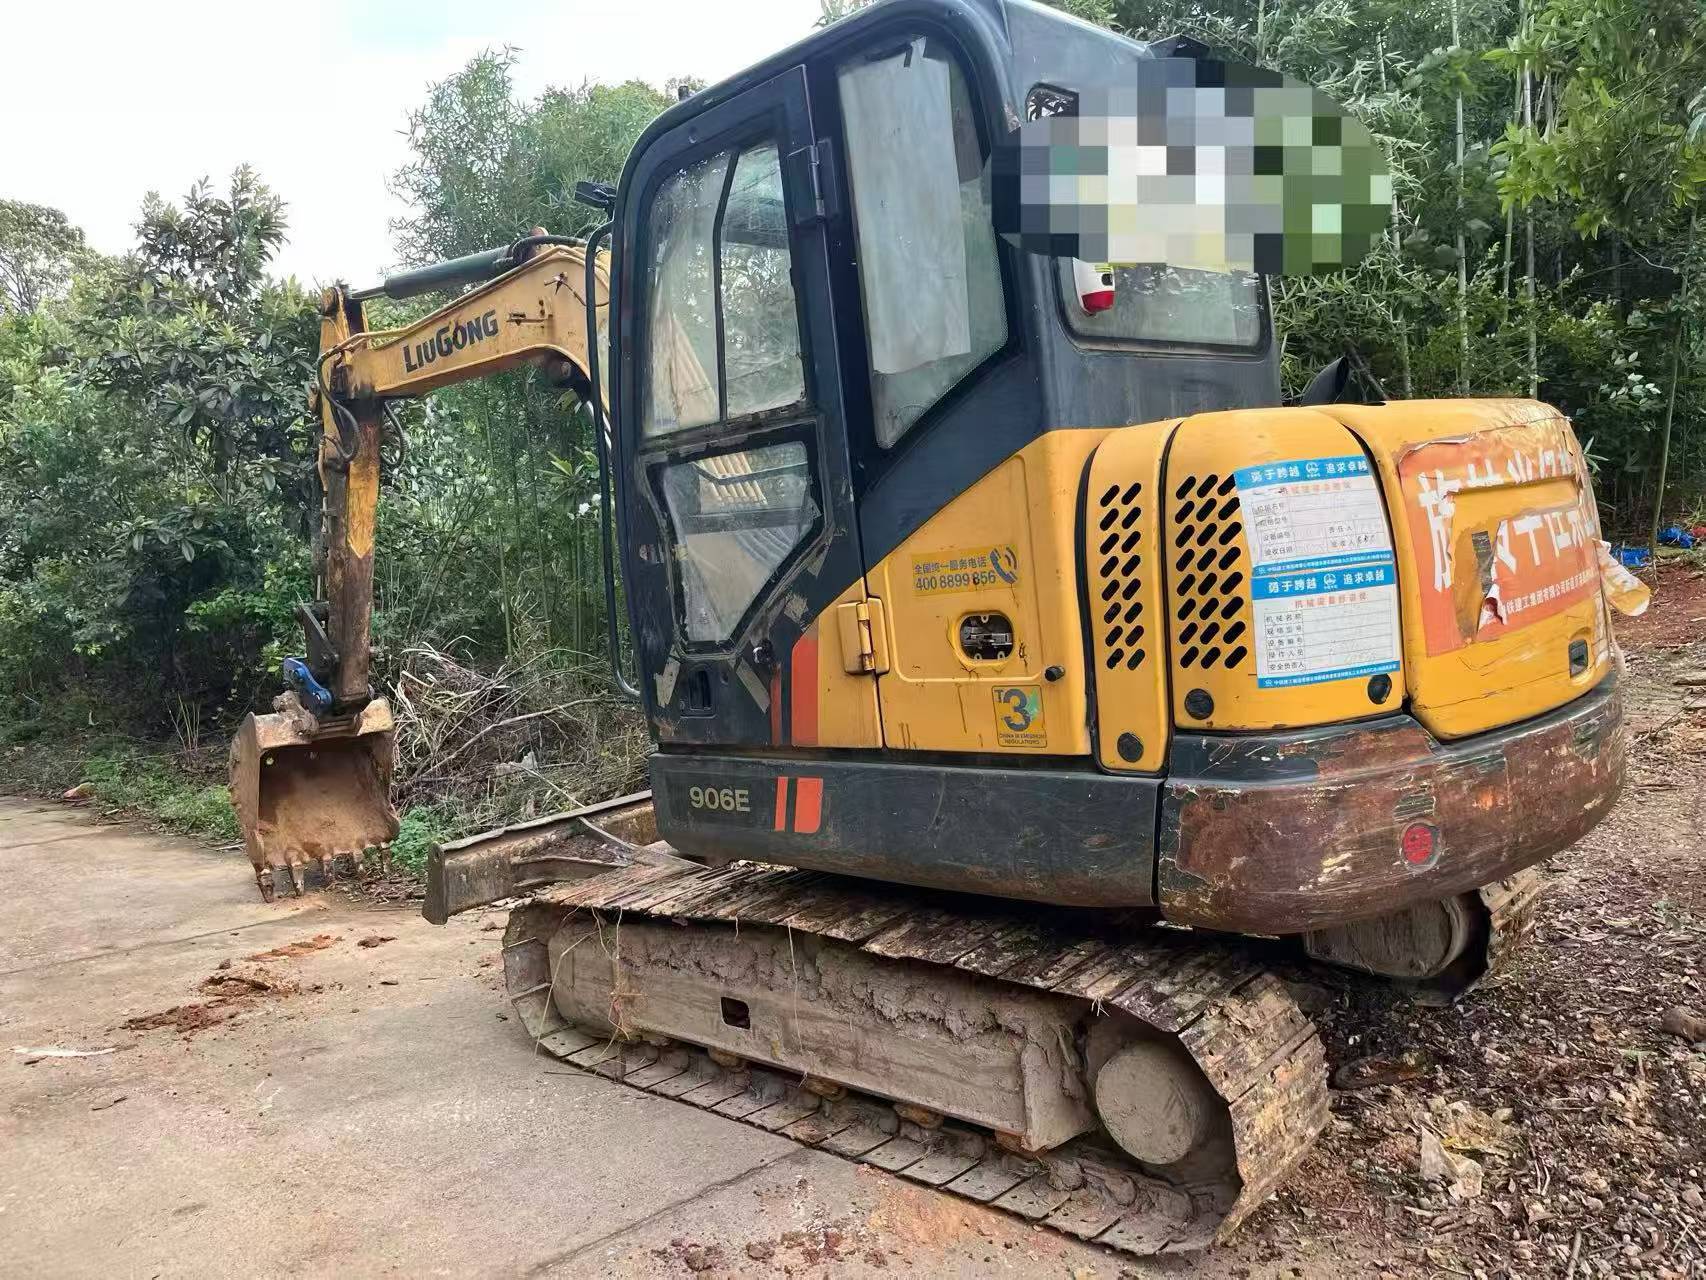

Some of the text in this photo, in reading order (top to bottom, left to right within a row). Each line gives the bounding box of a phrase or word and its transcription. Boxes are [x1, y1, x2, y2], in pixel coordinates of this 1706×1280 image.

[914, 556, 987, 575] 全国统一服务电话
[915, 570, 997, 591] 400 8899 856
[1268, 569, 1385, 594] 勇于跨越 追求卓越
[1269, 661, 1305, 670] 安全负责人
[689, 786, 750, 812] 906E
